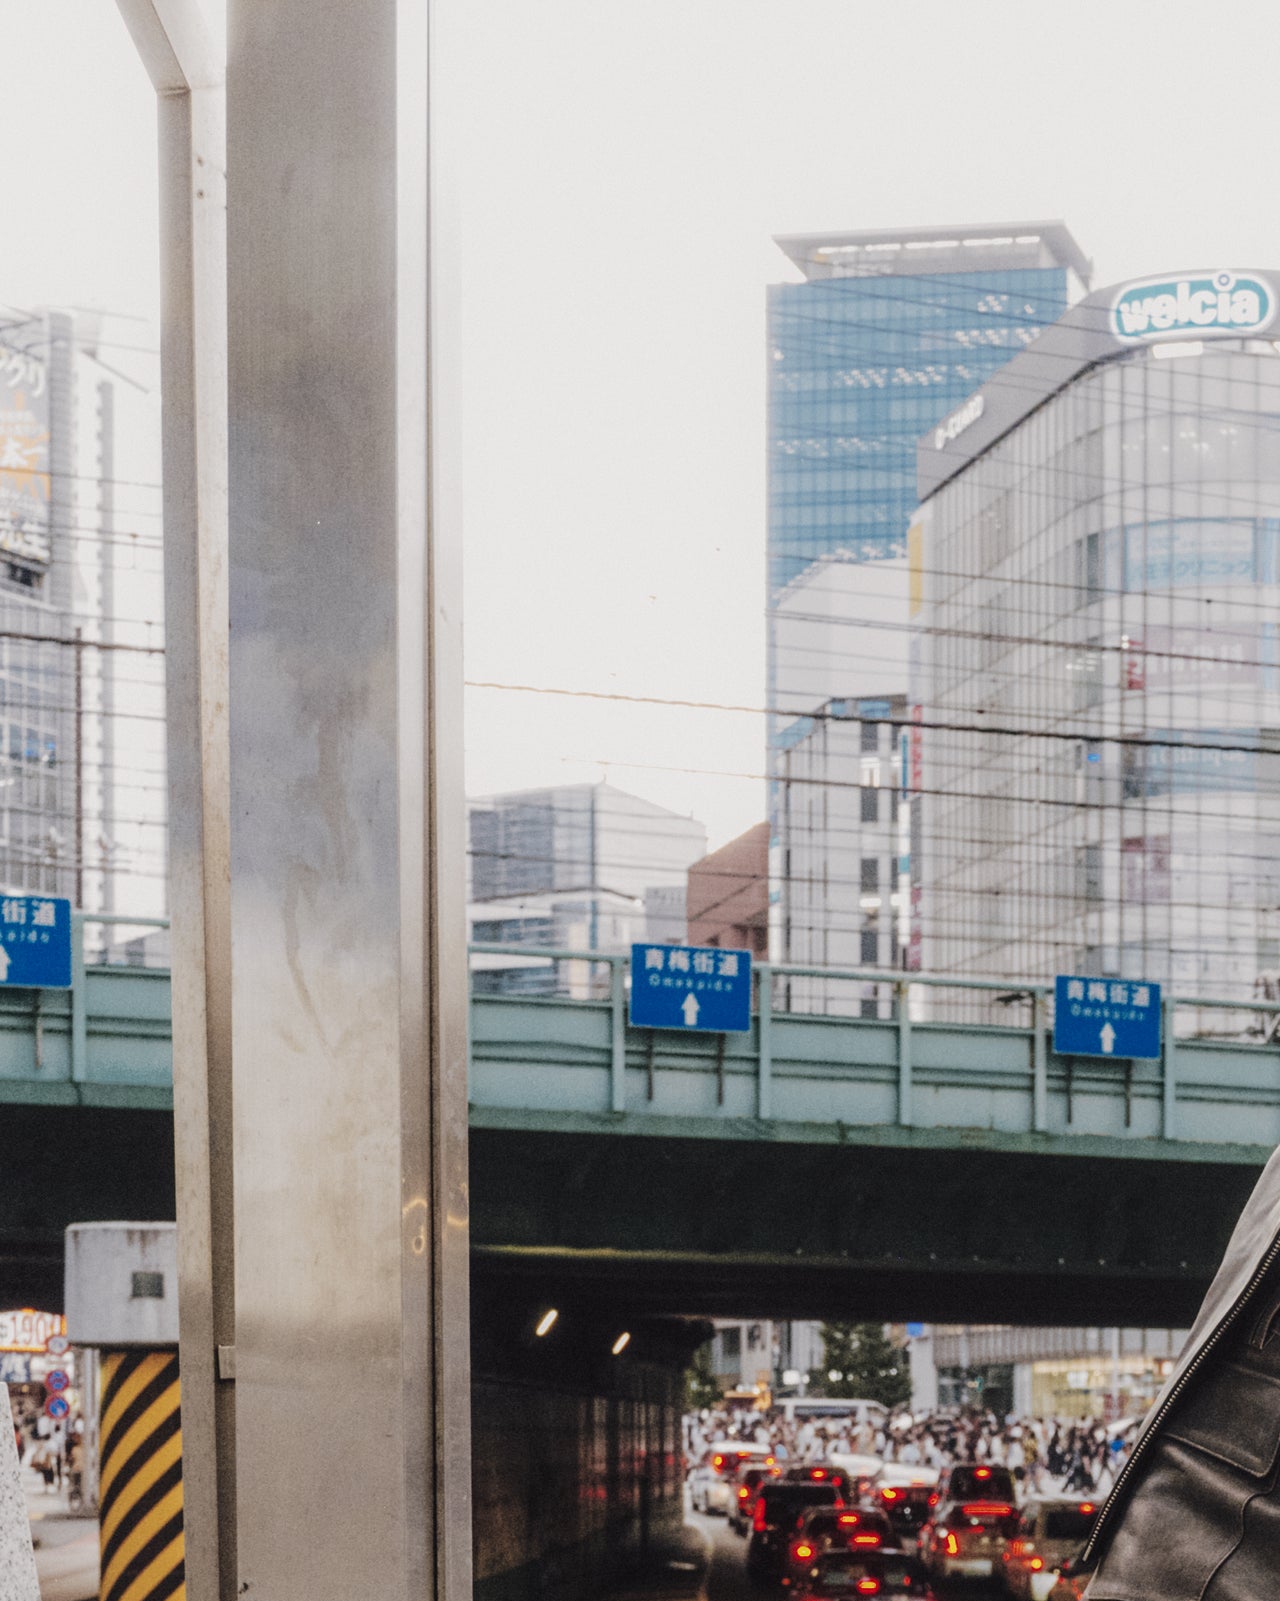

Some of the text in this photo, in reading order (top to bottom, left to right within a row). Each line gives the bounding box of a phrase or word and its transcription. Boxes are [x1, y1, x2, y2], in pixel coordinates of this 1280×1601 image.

[1119, 272, 1261, 334] welcia
[644, 948, 739, 977] 青梅街道
